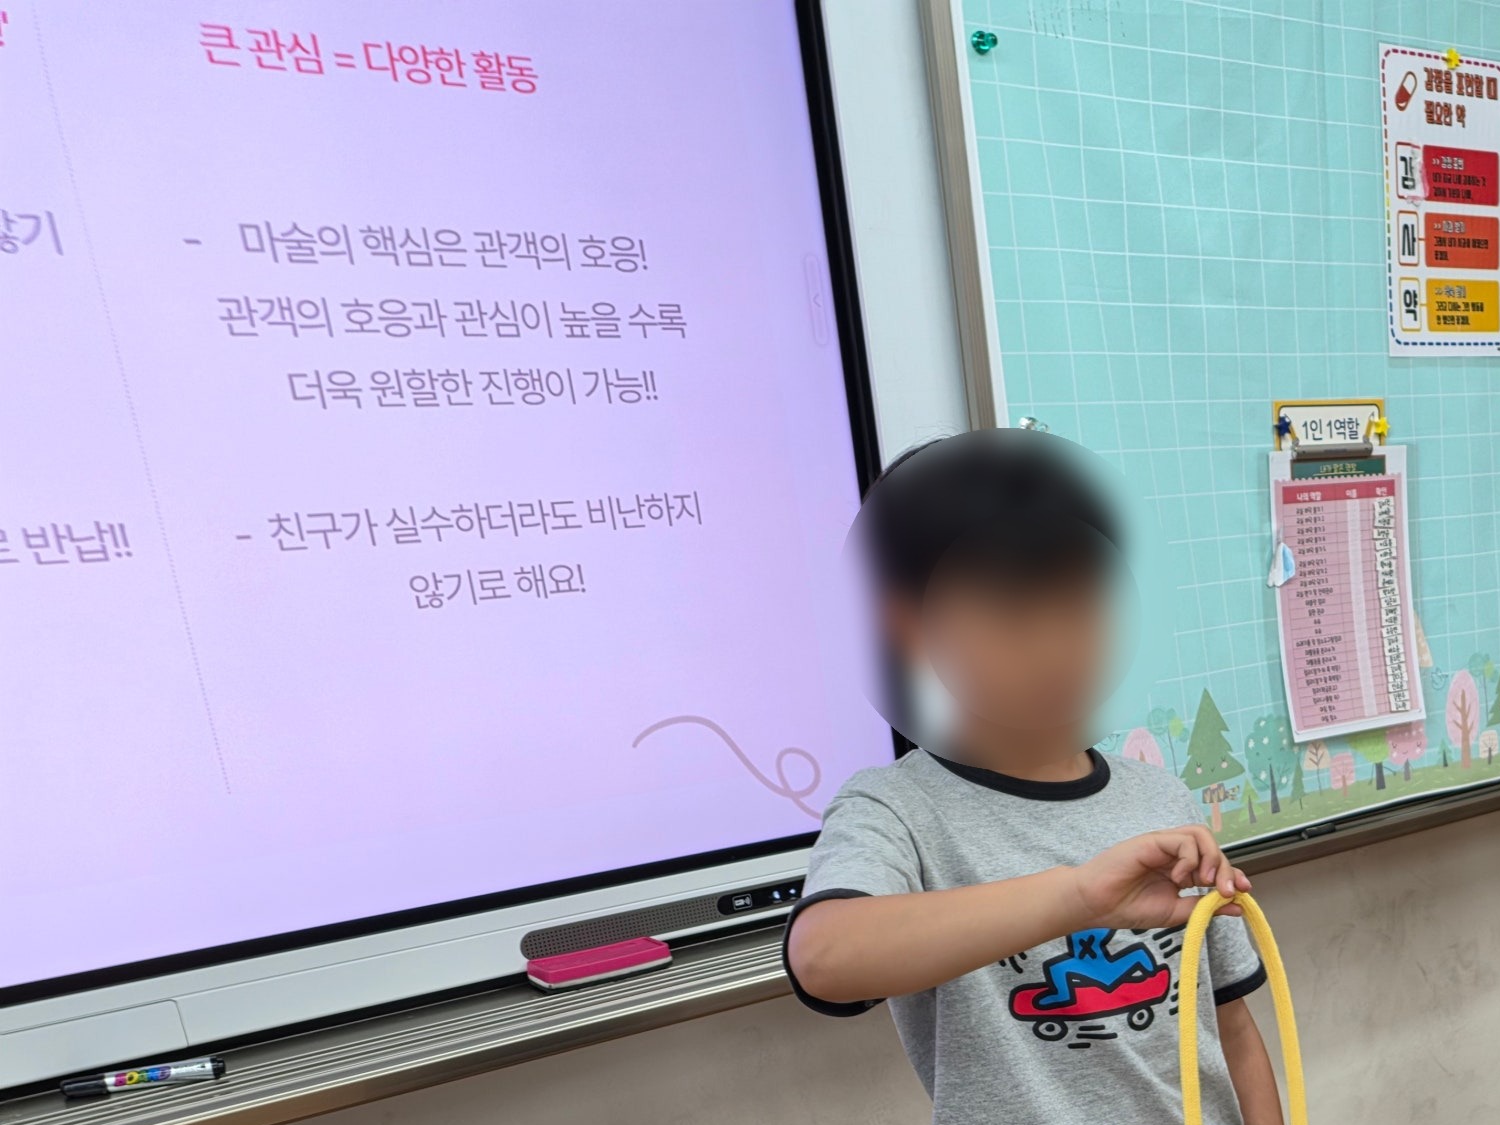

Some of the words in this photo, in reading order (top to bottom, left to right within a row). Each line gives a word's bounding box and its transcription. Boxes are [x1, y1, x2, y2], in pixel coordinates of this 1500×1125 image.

[200, 23, 240, 67] 큰
[246, 29, 324, 75] 관심
[363, 41, 467, 87] 다양한
[472, 51, 538, 94] 활동
[1400, 155, 1416, 190] 감
[239, 221, 354, 265] 마술의
[359, 226, 467, 267] 핵심은
[474, 230, 571, 271] 관객의
[578, 235, 648, 272] 호응!
[1402, 223, 1417, 257] 사
[218, 296, 333, 337] 관객의
[341, 298, 447, 337] 호응과
[454, 300, 552, 338] 관심이
[560, 302, 621, 338] 높을
[629, 304, 687, 338] 수록
[1403, 288, 1418, 322] 약
[288, 370, 362, 409] 더욱
[370, 369, 473, 407] 원할한
[479, 368, 576, 405] 진행이
[583, 368, 658, 404] 가능!!
[1302, 418, 1323, 440] 1인
[1326, 417, 1360, 440] 1역할
[268, 509, 378, 551] 친구가
[386, 500, 582, 544] 실수하더라도
[586, 491, 703, 529] 비난하지
[21, 520, 133, 565] 반납!!
[410, 569, 511, 609] 않기로
[514, 564, 586, 599] 해요!
